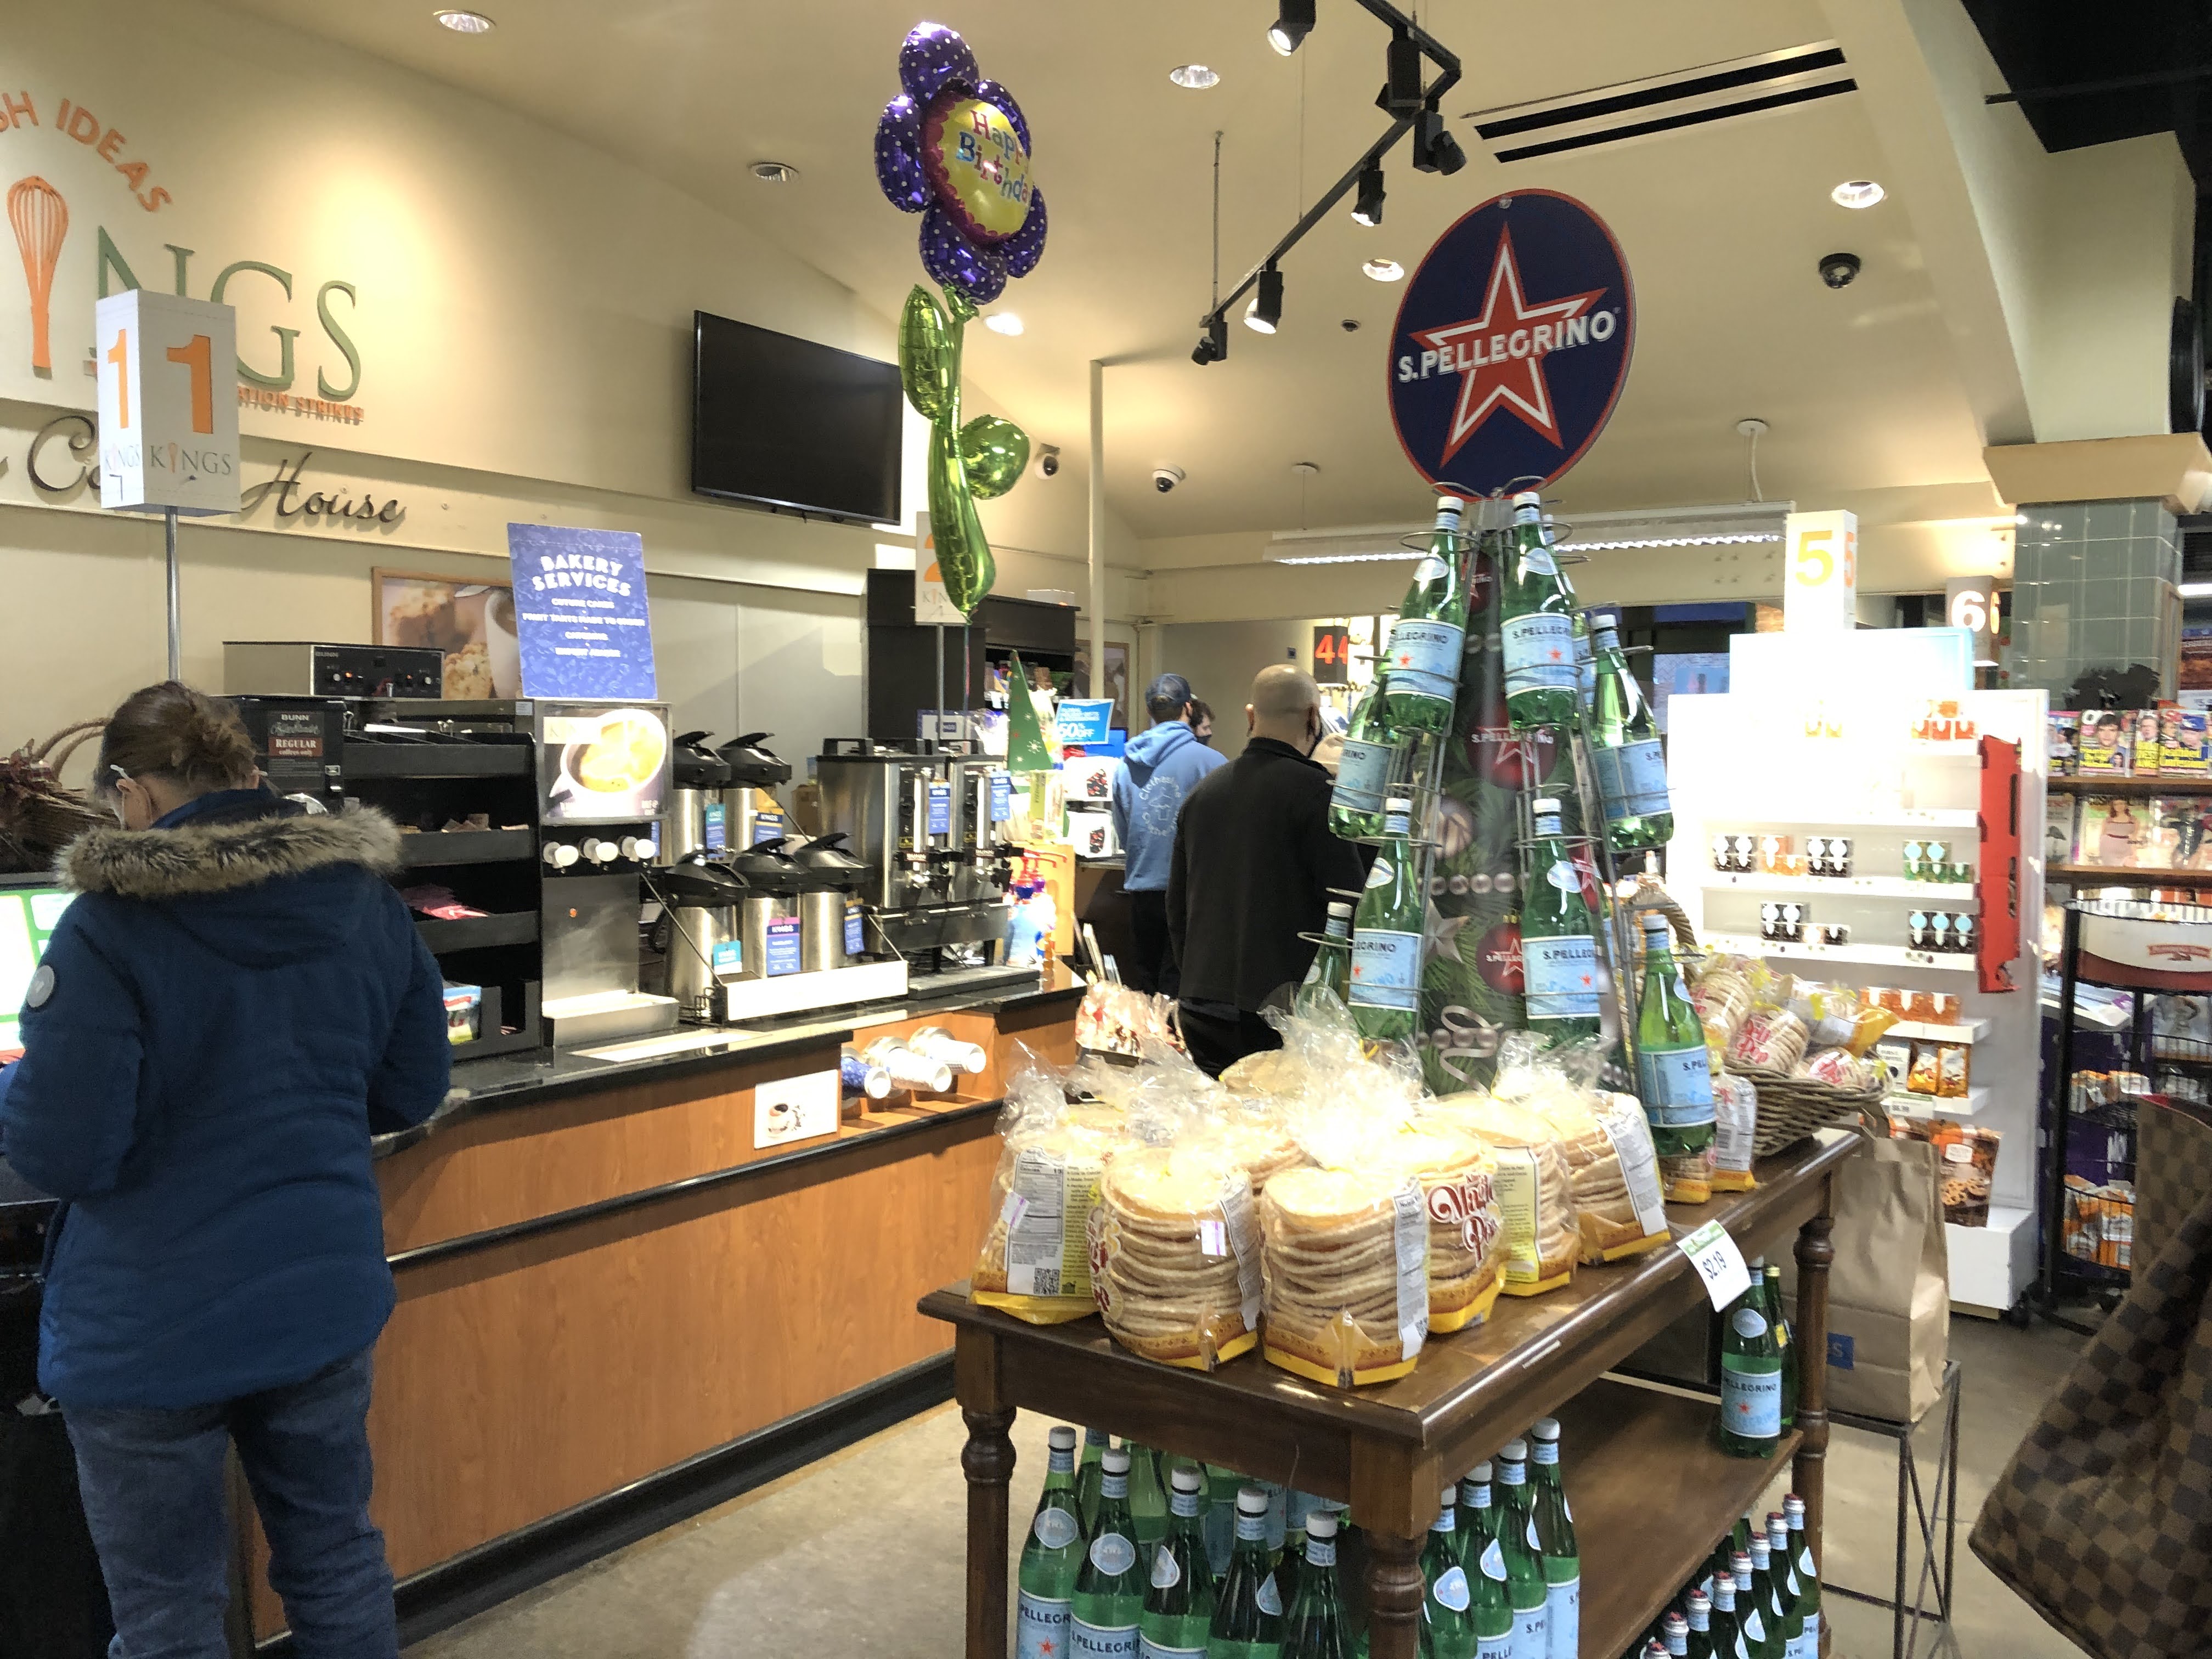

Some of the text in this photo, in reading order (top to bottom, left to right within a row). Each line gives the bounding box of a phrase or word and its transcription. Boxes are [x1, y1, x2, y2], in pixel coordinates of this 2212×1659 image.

[55, 98, 173, 213] IDEAS
[1397, 311, 1617, 383] S.PELLEGRINO
[108, 330, 129, 429] 1
[167, 335, 213, 435] 1
[296, 397, 364, 422] STRIKES
[150, 442, 232, 476] KINGS
[241, 452, 406, 523] House
[540, 554, 623, 577] BAKERY
[1795, 530, 1834, 586] 5
[1844, 531, 1855, 588] 5
[532, 572, 631, 597] SERVICES
[1951, 590, 1987, 632] 6
[1990, 591, 2000, 634] 6
[1315, 634, 1335, 664] 4
[276, 738, 317, 748] REGULAR
[1702, 1250, 1727, 1280] $2.19
